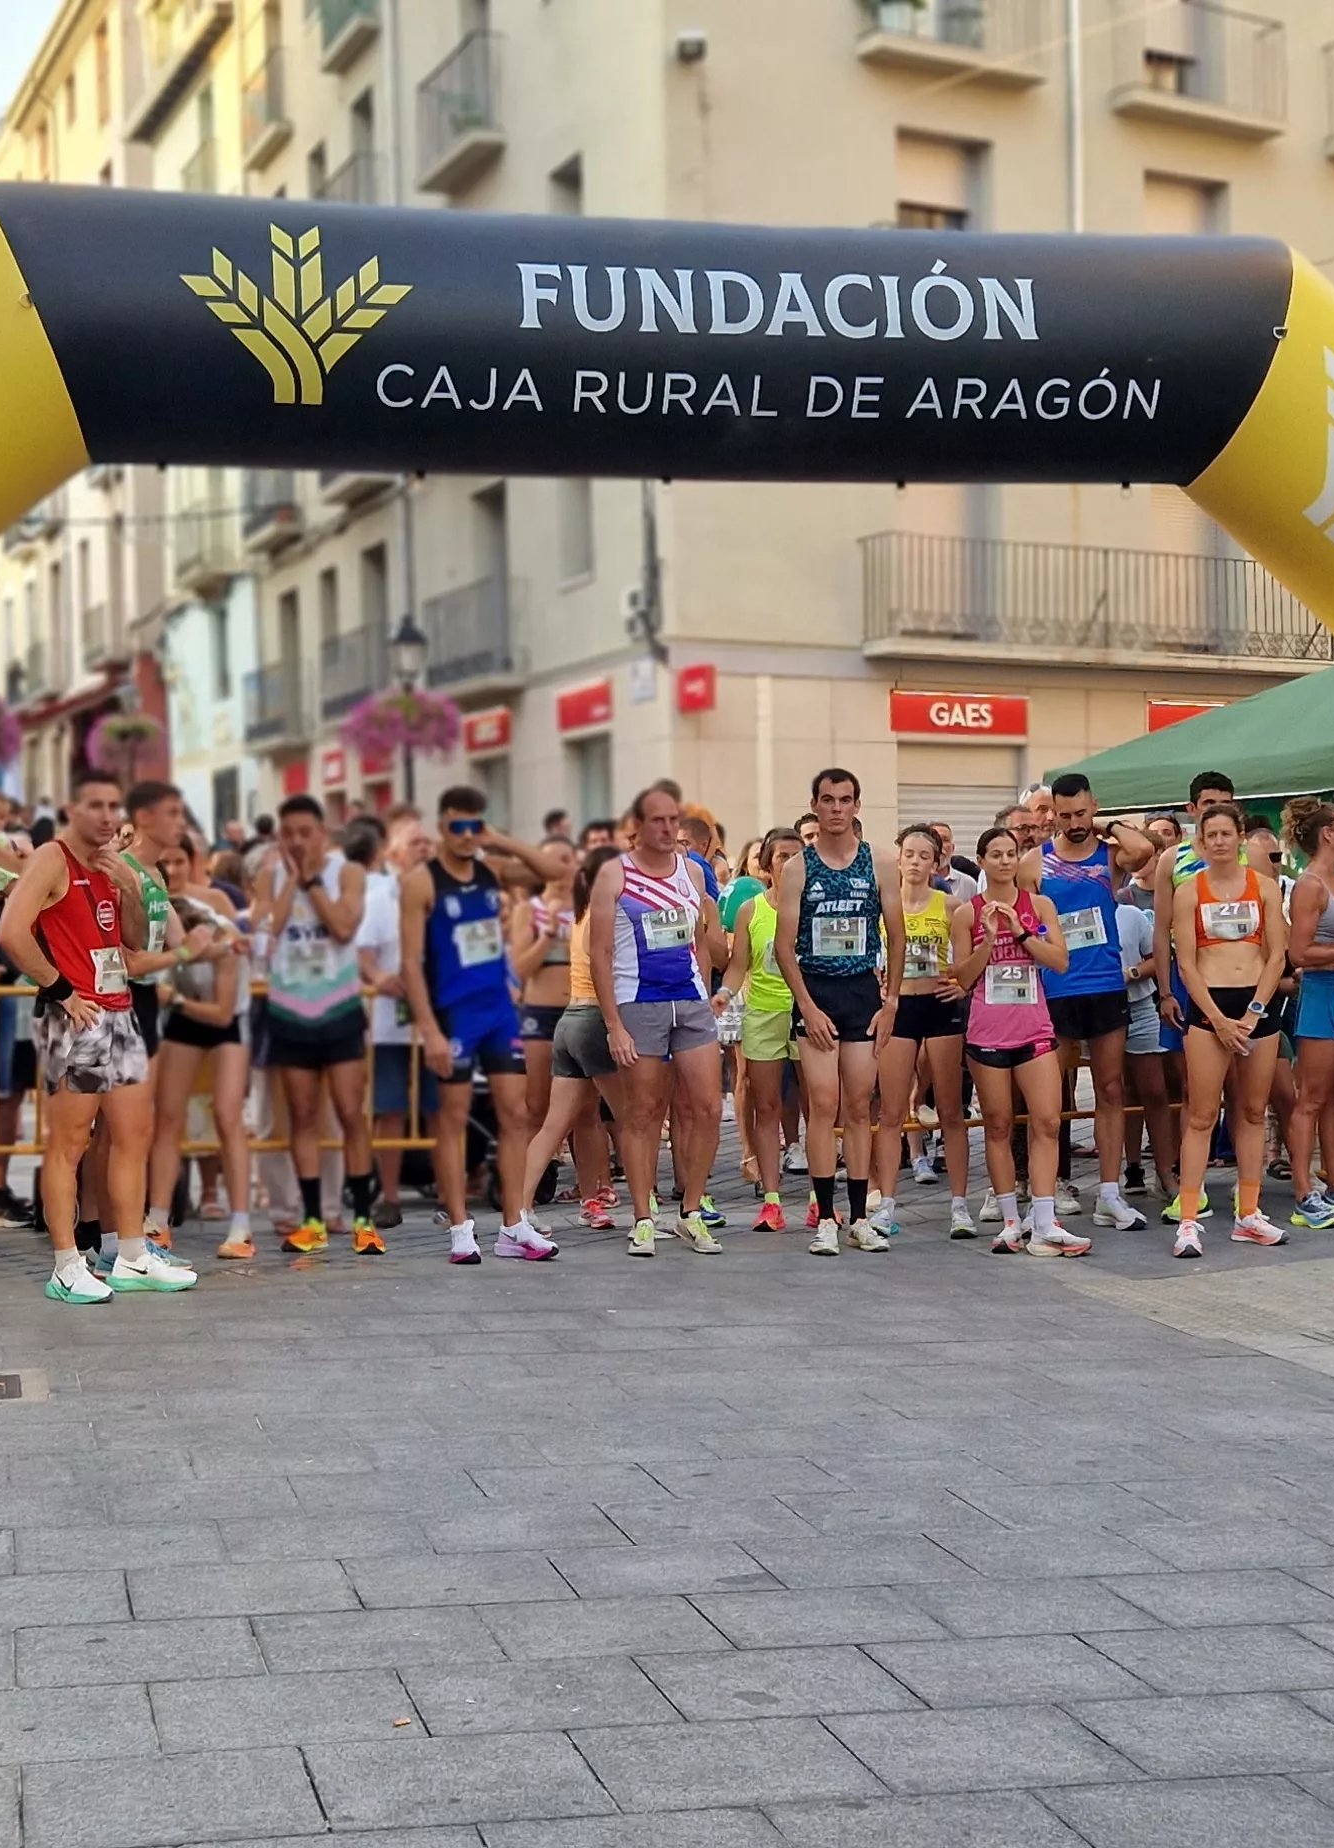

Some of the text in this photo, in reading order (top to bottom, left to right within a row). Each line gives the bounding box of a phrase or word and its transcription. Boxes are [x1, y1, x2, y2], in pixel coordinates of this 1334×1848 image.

[516, 258, 1040, 342] FUNDACIÓN
[376, 363, 1162, 421] CAJA RURAL DE ARAGÓN
[929, 702, 994, 728] GAES
[815, 899, 864, 914] ATLEET
[1219, 902, 1241, 916] 27
[659, 909, 679, 924] 10
[830, 918, 851, 932] 13
[1002, 966, 1023, 980] 25
